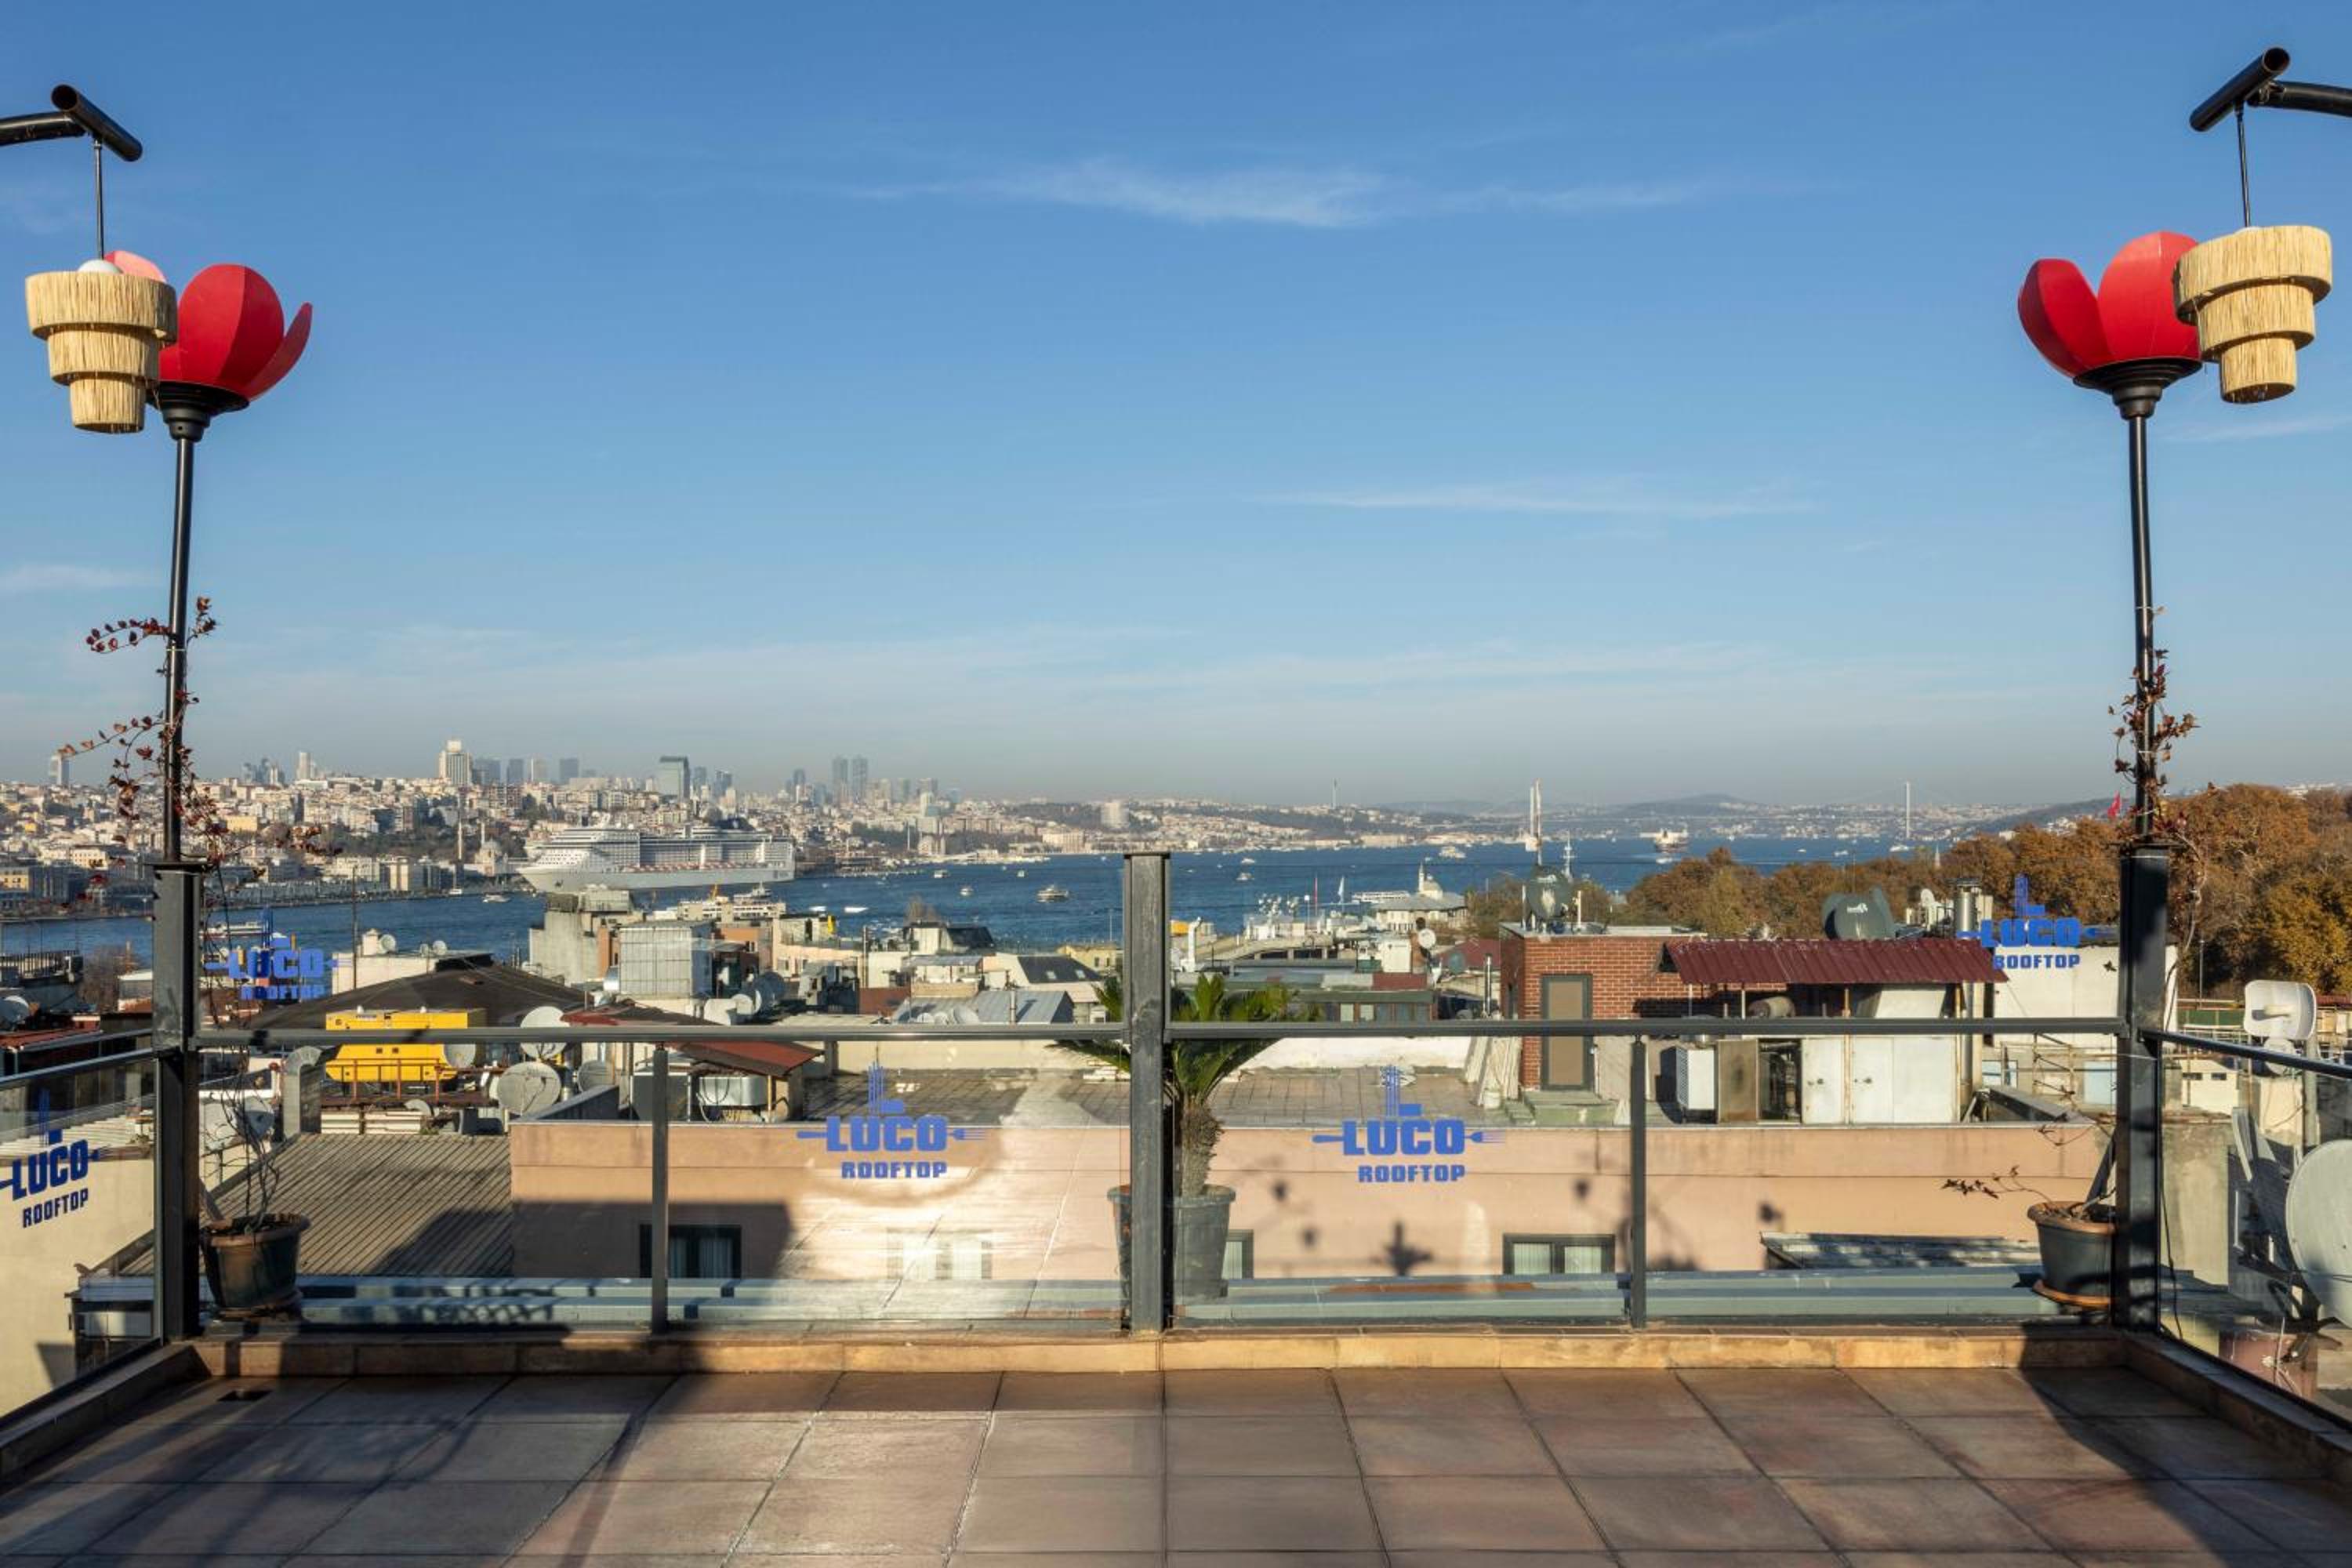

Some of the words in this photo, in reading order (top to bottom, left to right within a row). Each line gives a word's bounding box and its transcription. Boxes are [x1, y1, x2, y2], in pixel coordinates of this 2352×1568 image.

[1980, 916, 2082, 948] LUCO
[228, 948, 325, 979] LUCO
[1994, 954, 2081, 971] ROOFTOP
[826, 1115, 947, 1152] LUCO
[1341, 1119, 1465, 1156] LUCO
[12, 1139, 89, 1201] LUCO
[841, 1161, 947, 1179] ROOFTOP
[1358, 1165, 1465, 1182] ROOFTOP
[23, 1188, 89, 1229] ROOFTOP
